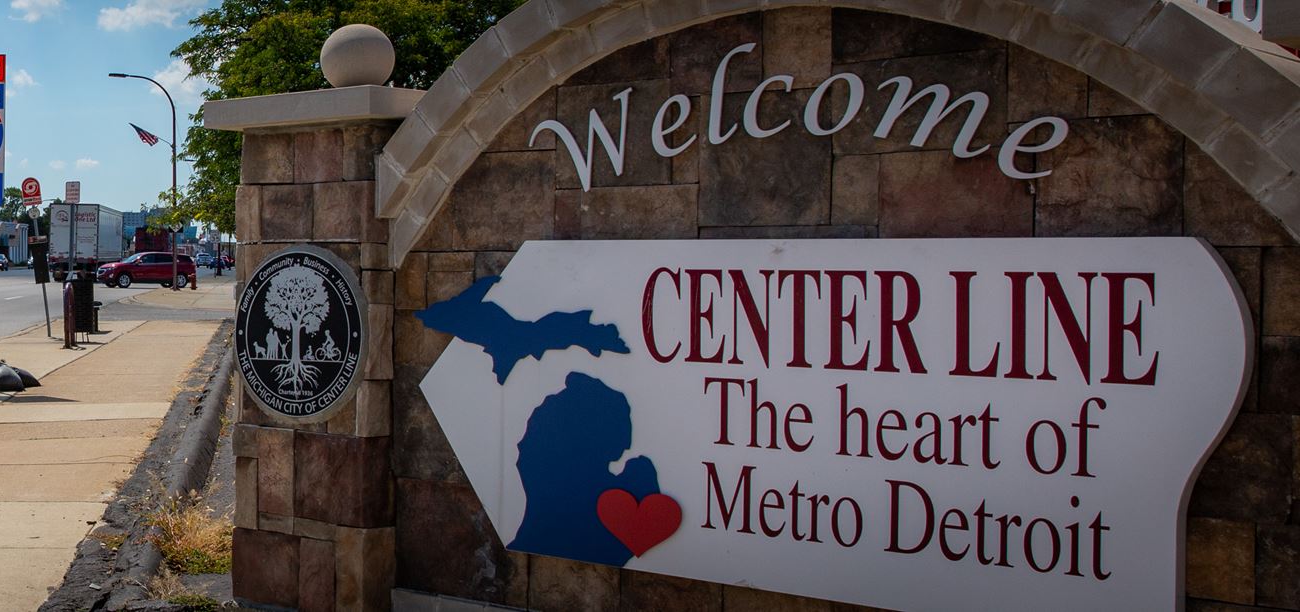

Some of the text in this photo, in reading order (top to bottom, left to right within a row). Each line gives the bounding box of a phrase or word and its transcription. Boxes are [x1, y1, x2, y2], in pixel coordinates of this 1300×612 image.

[529, 42, 1069, 192] Welcome
[241, 256, 353, 313] Family Community Business History
[642, 267, 1160, 386] CENTER LINE
[239, 349, 358, 414] THE MICHIGAN CITY OF CENTER LINE
[704, 377, 1107, 478] The heart of
[701, 461, 1112, 581] Metro Detroit
